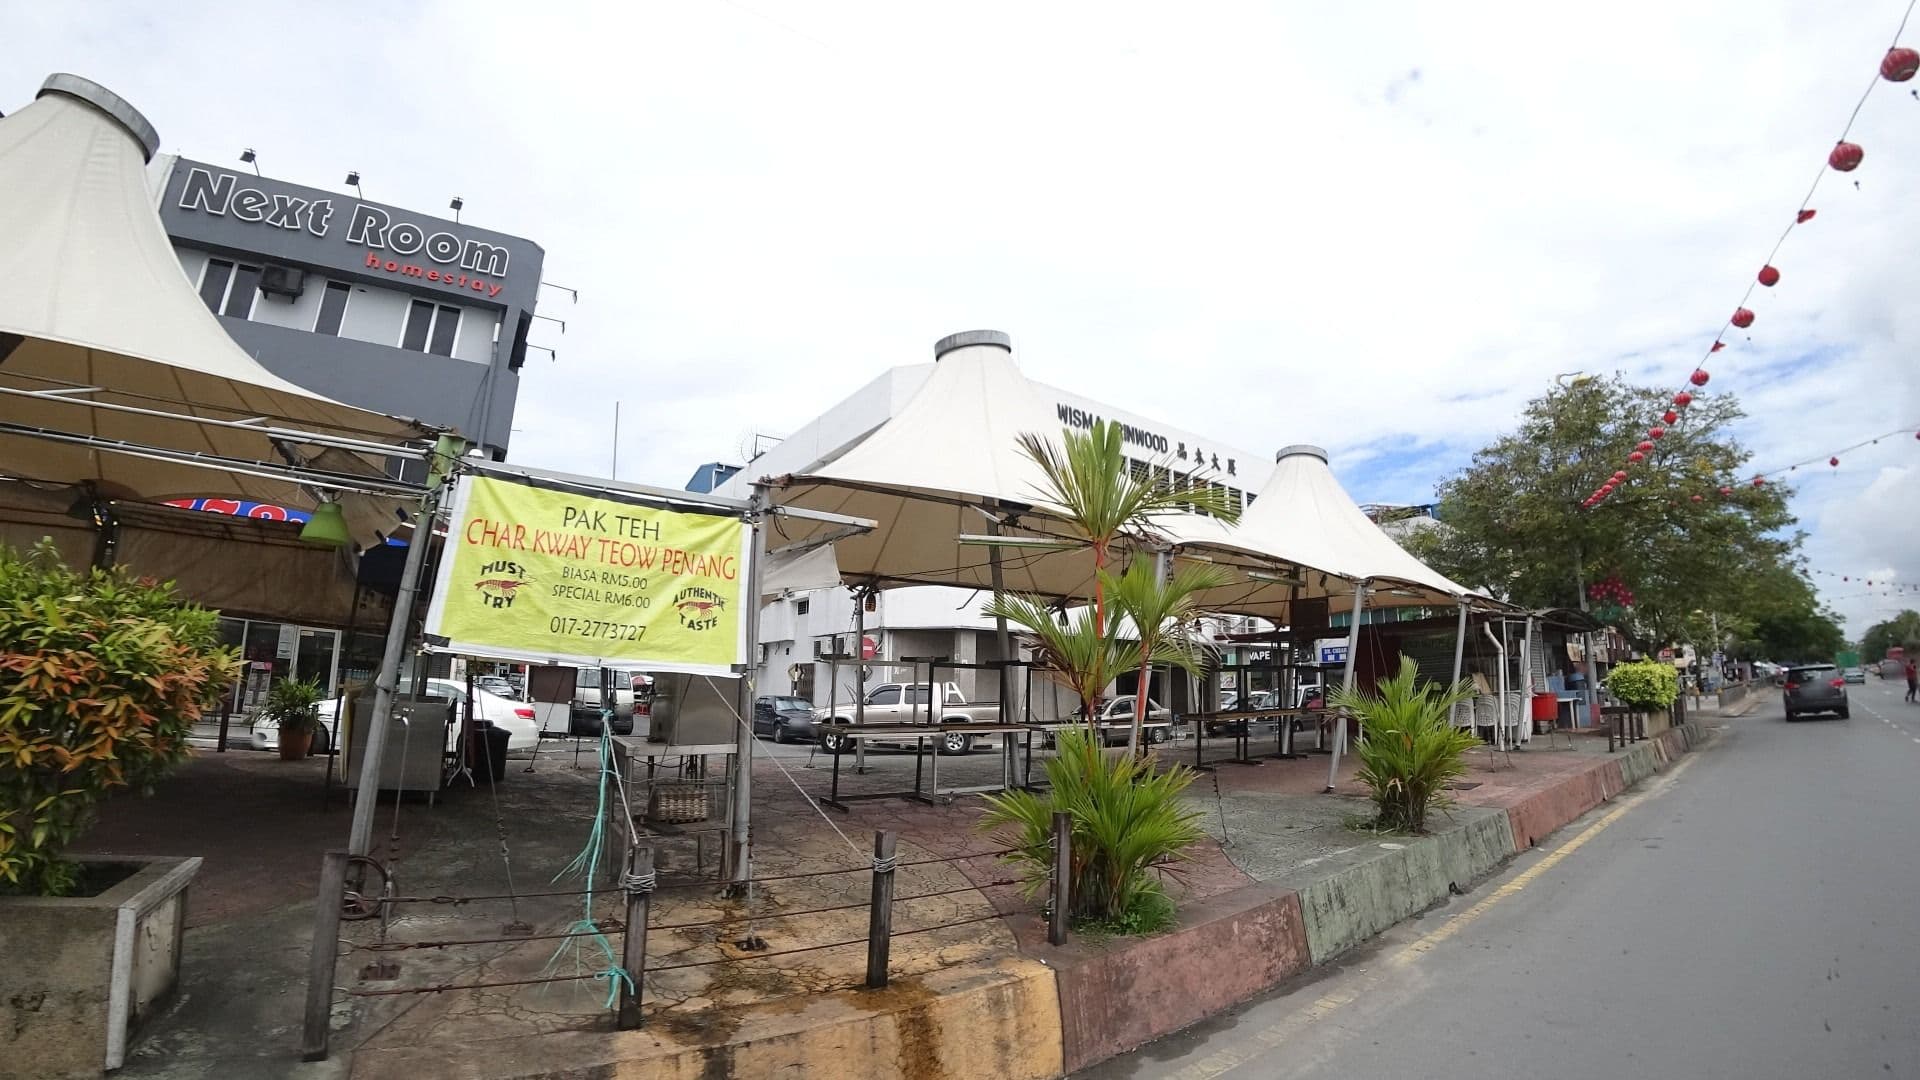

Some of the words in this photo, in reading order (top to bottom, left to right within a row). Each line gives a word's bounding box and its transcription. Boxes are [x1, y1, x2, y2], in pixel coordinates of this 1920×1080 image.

[178, 167, 334, 238] Next
[345, 203, 510, 277] Room
[365, 251, 504, 297] homestay
[1119, 423, 1168, 454] INWOOD
[562, 506, 608, 533] PAK
[615, 515, 660, 541] TEH
[466, 518, 526, 551] CHAR
[532, 530, 593, 560] KWAY
[598, 538, 657, 570] TEOW
[662, 548, 736, 581] PENANG
[481, 560, 527, 579] MUST
[562, 566, 599, 583] BIASA
[601, 570, 648, 590] RM5.00
[482, 591, 516, 609] TRY
[552, 585, 601, 603] SPECIAL
[604, 590, 651, 609] RM6.00
[550, 615, 647, 642] 017-2773727
[679, 612, 718, 631] TASTE
[1249, 650, 1271, 661] VAPE
